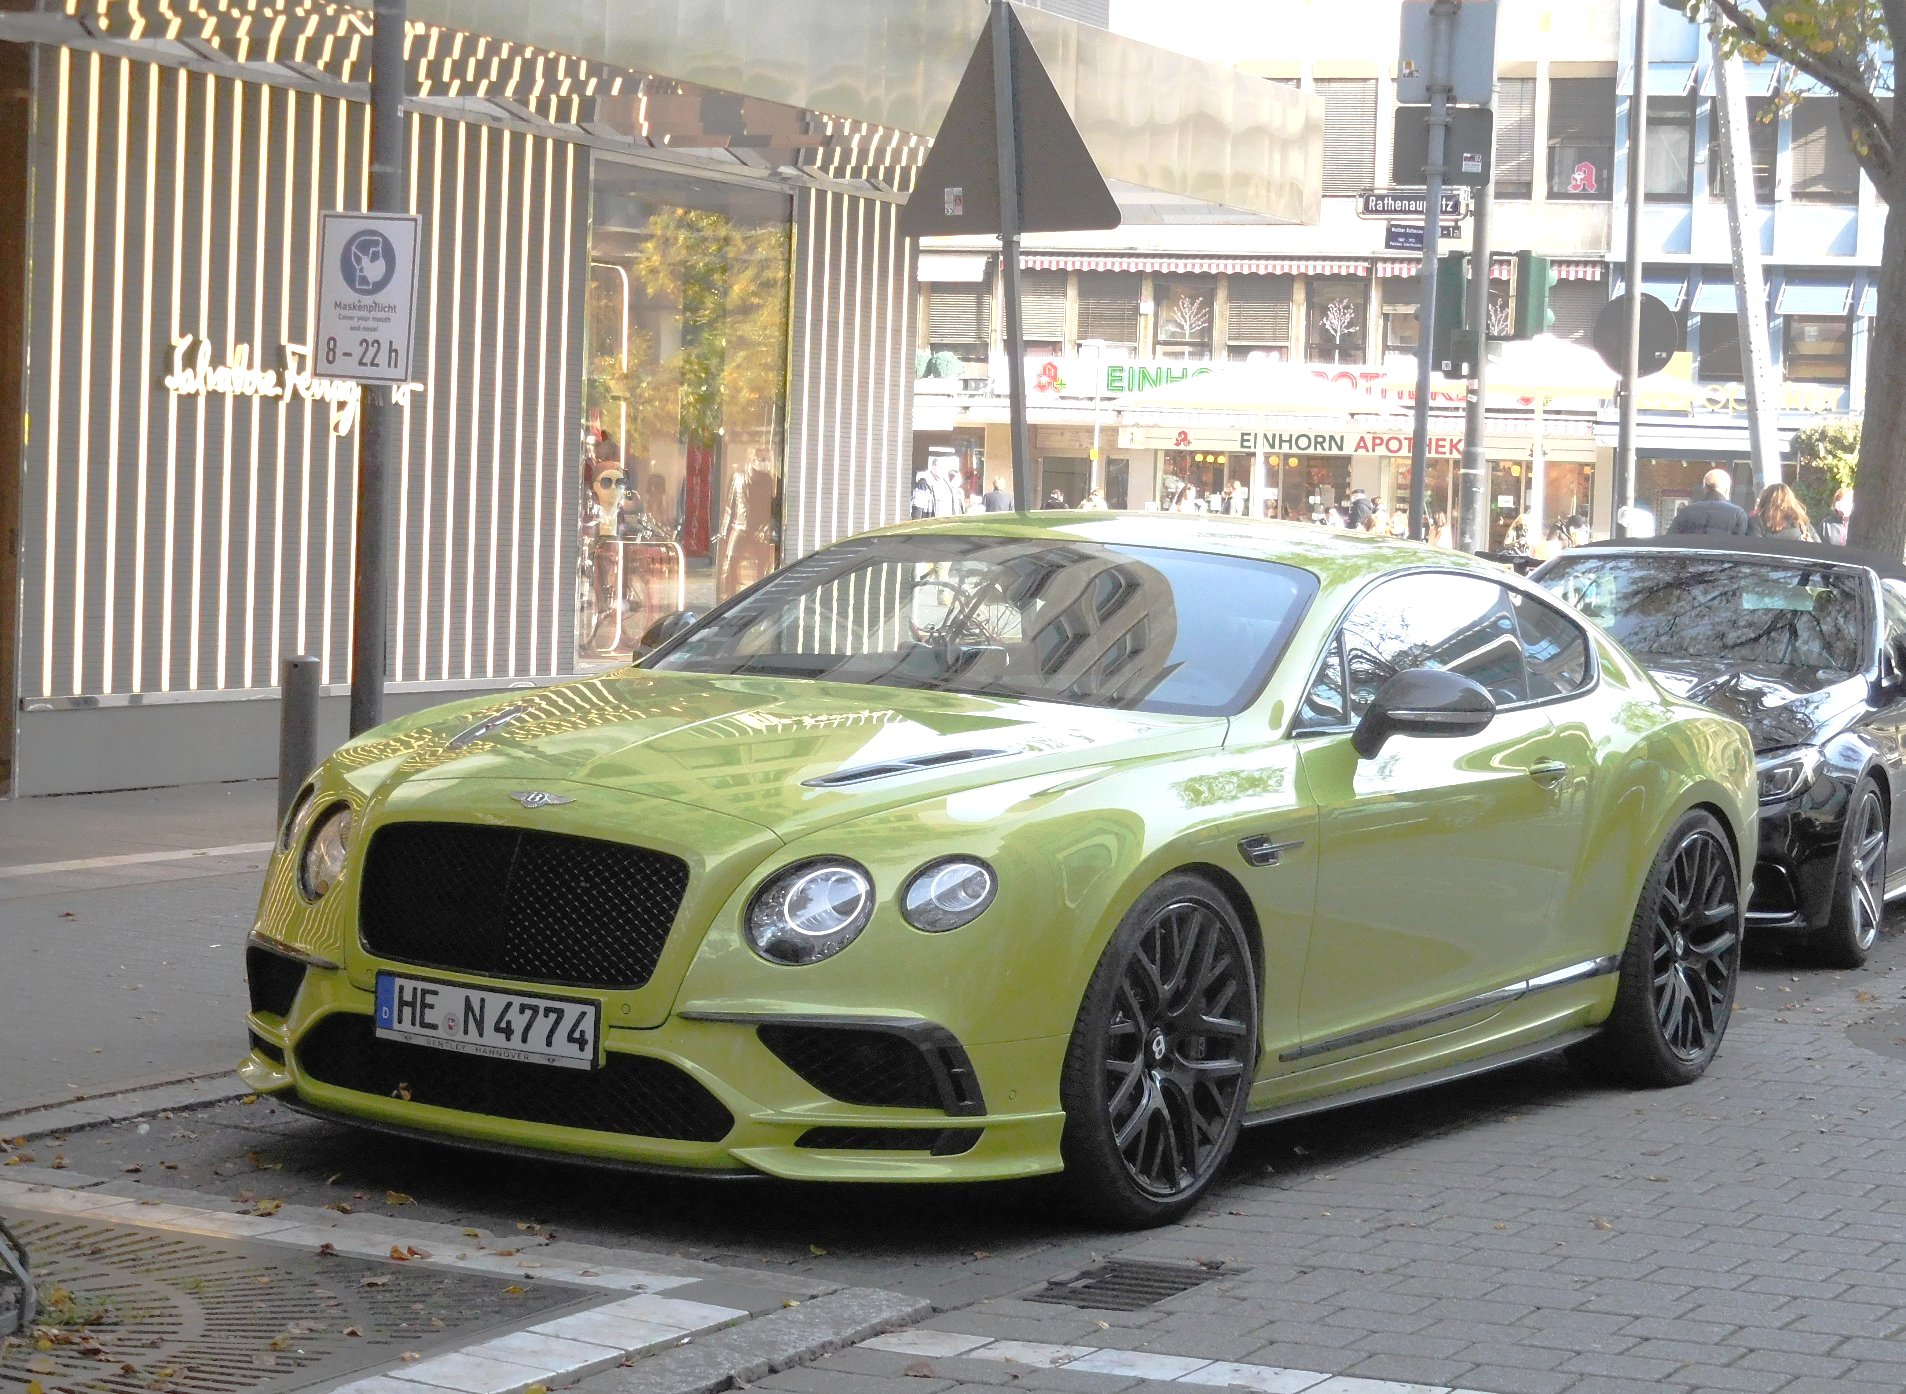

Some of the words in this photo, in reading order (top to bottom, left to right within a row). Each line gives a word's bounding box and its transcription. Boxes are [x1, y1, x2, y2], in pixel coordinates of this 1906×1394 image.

[1368, 195, 1454, 213] Rathenautz
[334, 300, 397, 314] Maskenpflicht
[337, 313, 355, 321] Cover
[356, 315, 371, 323] your
[325, 336, 338, 365] 8
[357, 337, 381, 368] 22
[387, 340, 399, 369] h
[284, 342, 424, 436] Ferrago
[1107, 365, 1214, 393] EINH
[1239, 432, 1345, 452] EINHORN
[1353, 435, 1464, 456] APOTHEK
[382, 1007, 390, 1019] D
[397, 984, 440, 1031] HE
[463, 994, 486, 1039] N
[493, 1001, 589, 1052] 4774
[426, 1038, 467, 1052] BENTLEY
[475, 1047, 530, 1061] HANNOVER
